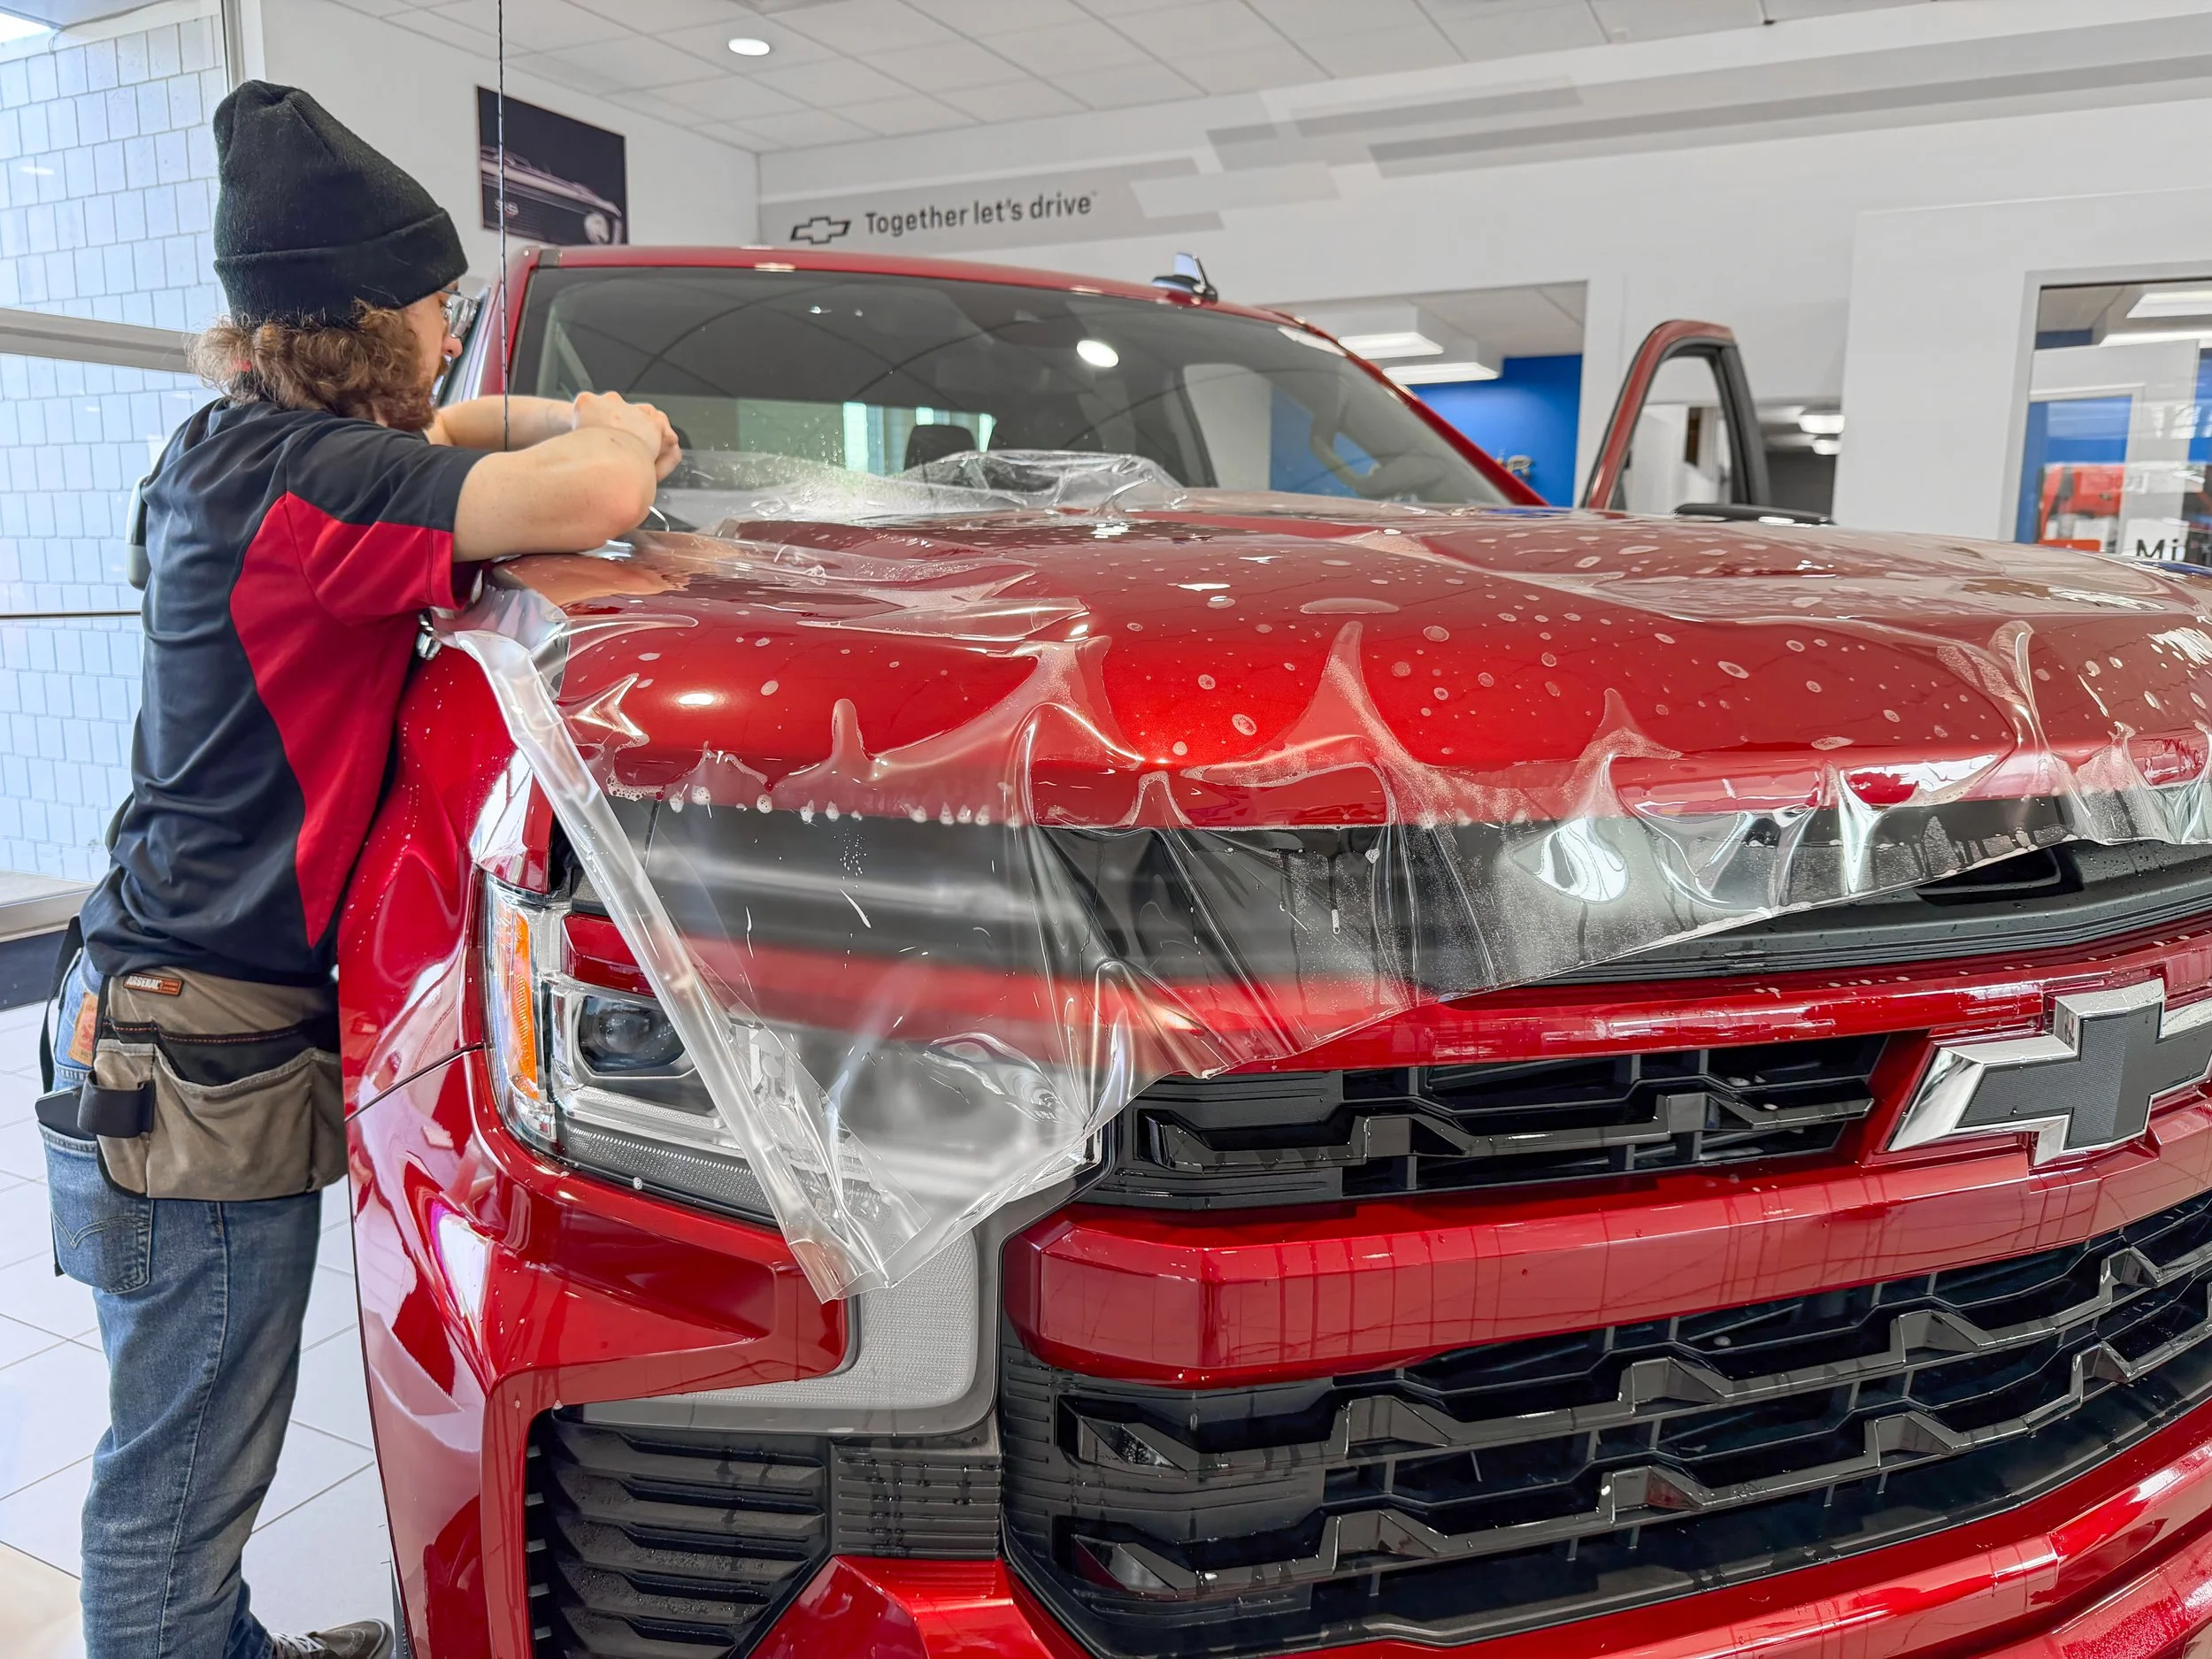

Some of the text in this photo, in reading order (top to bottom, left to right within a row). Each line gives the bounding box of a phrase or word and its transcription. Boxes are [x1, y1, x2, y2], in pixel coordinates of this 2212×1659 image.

[864, 191, 1092, 238] Together let's drive
